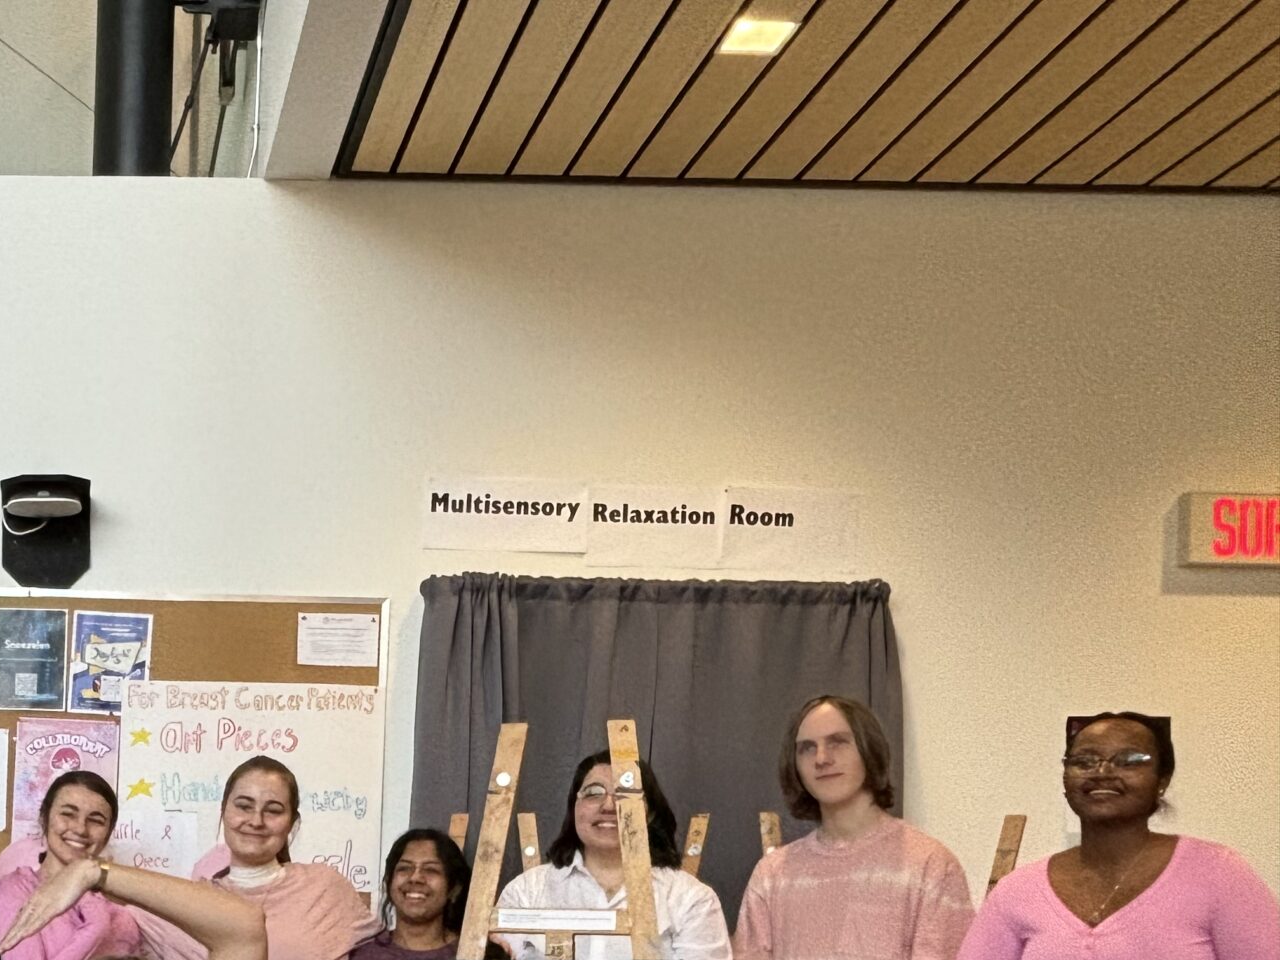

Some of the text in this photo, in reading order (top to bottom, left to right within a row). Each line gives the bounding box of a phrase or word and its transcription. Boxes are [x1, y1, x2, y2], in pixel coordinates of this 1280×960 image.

[429, 492, 795, 527] Multisensory Relaxation Room
[127, 684, 162, 709] For
[166, 685, 230, 711] Breast
[235, 687, 304, 712] Cancer
[159, 717, 299, 754] Art Pieces
